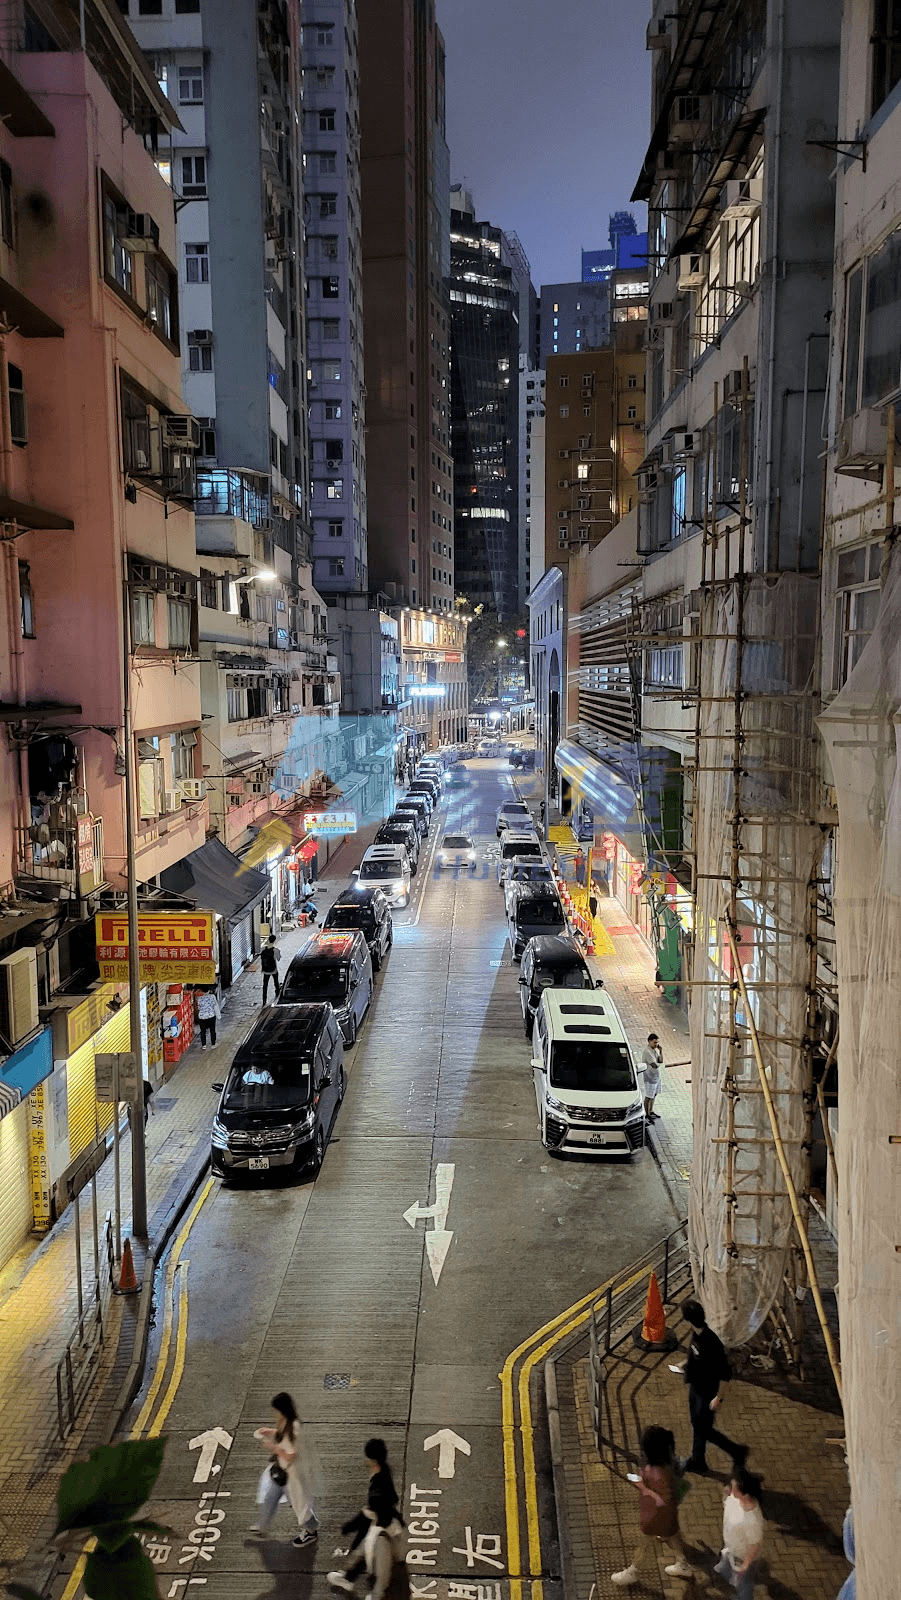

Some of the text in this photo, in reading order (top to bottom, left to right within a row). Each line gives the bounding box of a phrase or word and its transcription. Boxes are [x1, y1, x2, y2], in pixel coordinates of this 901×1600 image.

[99, 947, 211, 959] 利源池膠輪有限公司
[101, 918, 207, 942] PIRELLI
[178, 1491, 231, 1565] LOOK
[406, 1483, 442, 1566] RIGHT
